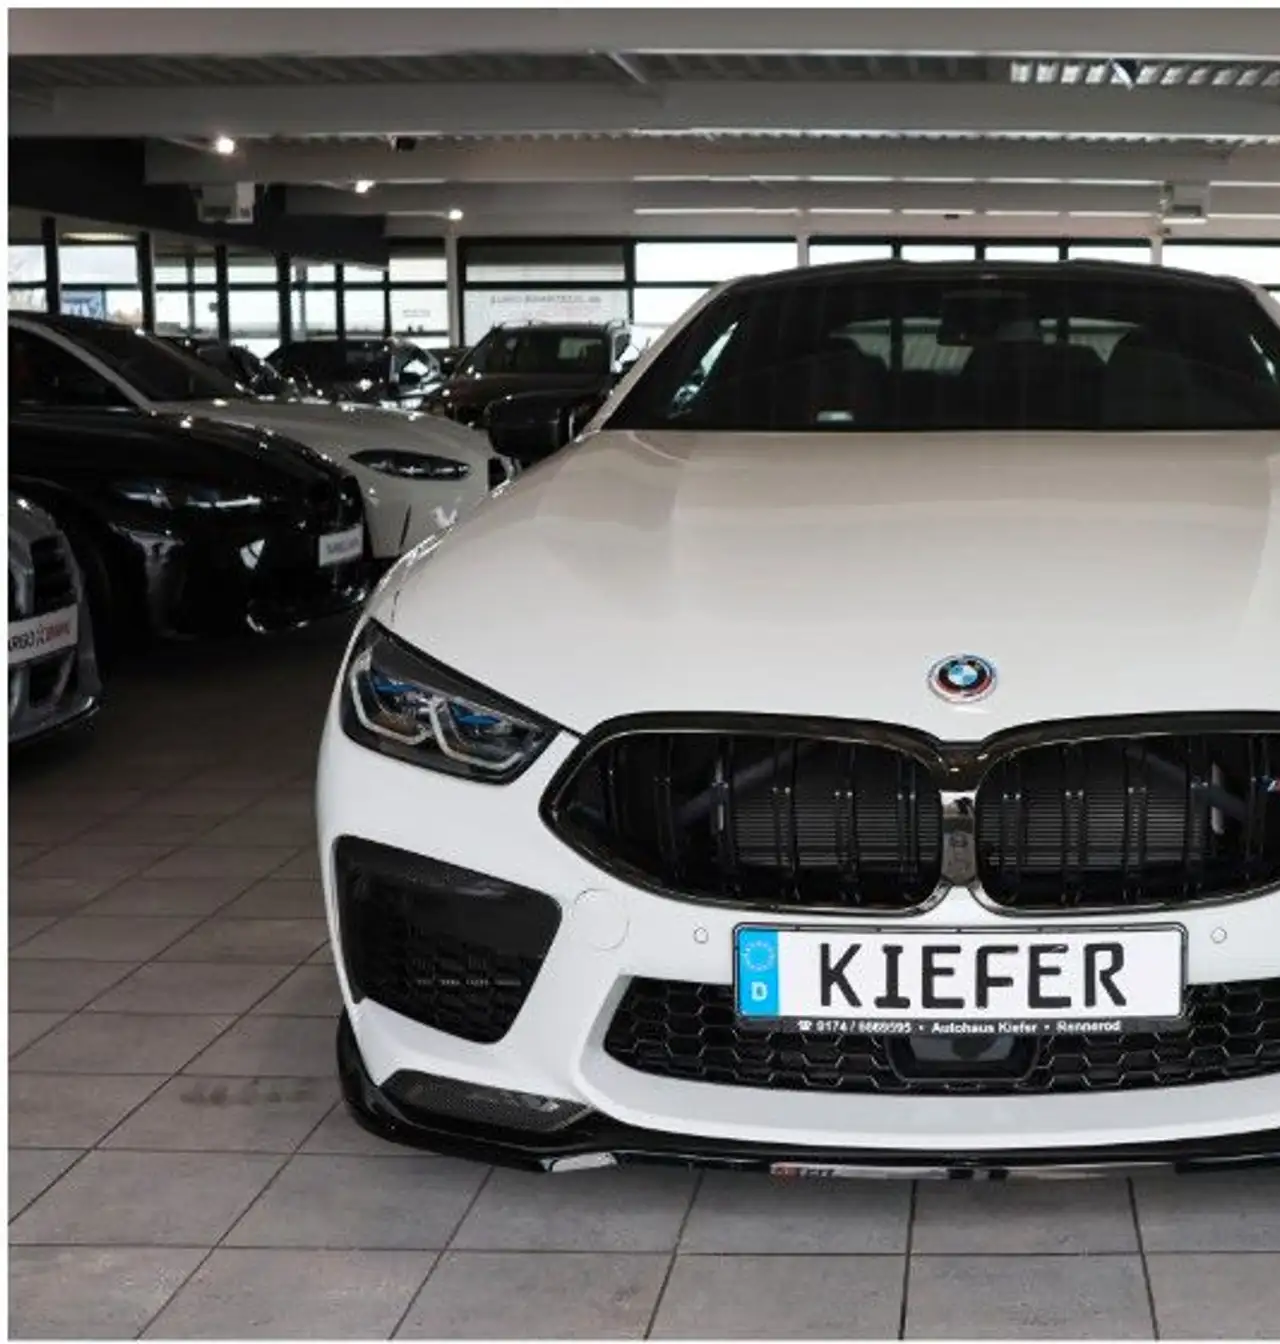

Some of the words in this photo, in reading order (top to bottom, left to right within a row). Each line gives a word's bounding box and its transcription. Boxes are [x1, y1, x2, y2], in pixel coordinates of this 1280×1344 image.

[819, 942, 1127, 1009] KIEFER
[931, 1021, 995, 1034] Autohaus
[998, 1021, 1036, 1033] Kiefer
